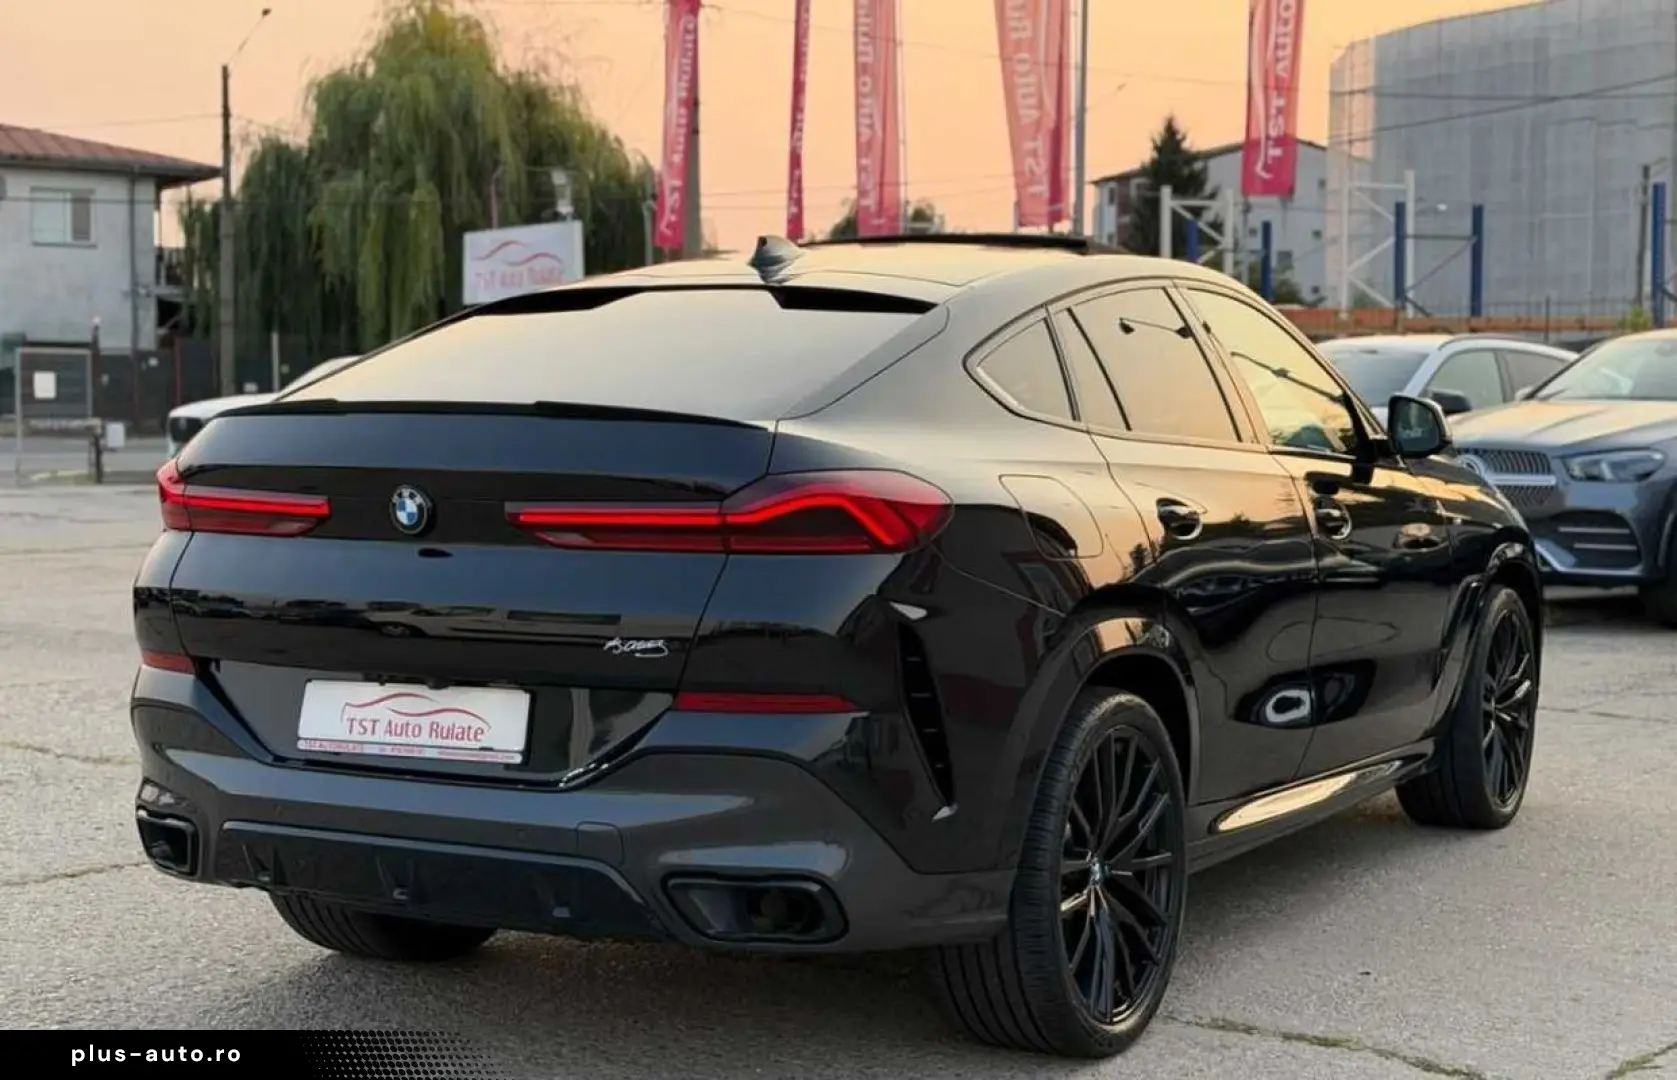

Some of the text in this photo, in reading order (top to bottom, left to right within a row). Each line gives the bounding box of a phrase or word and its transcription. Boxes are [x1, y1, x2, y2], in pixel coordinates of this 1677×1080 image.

[1267, 90, 1286, 164] TST
[347, 717, 484, 742] TST Auto Rulate
